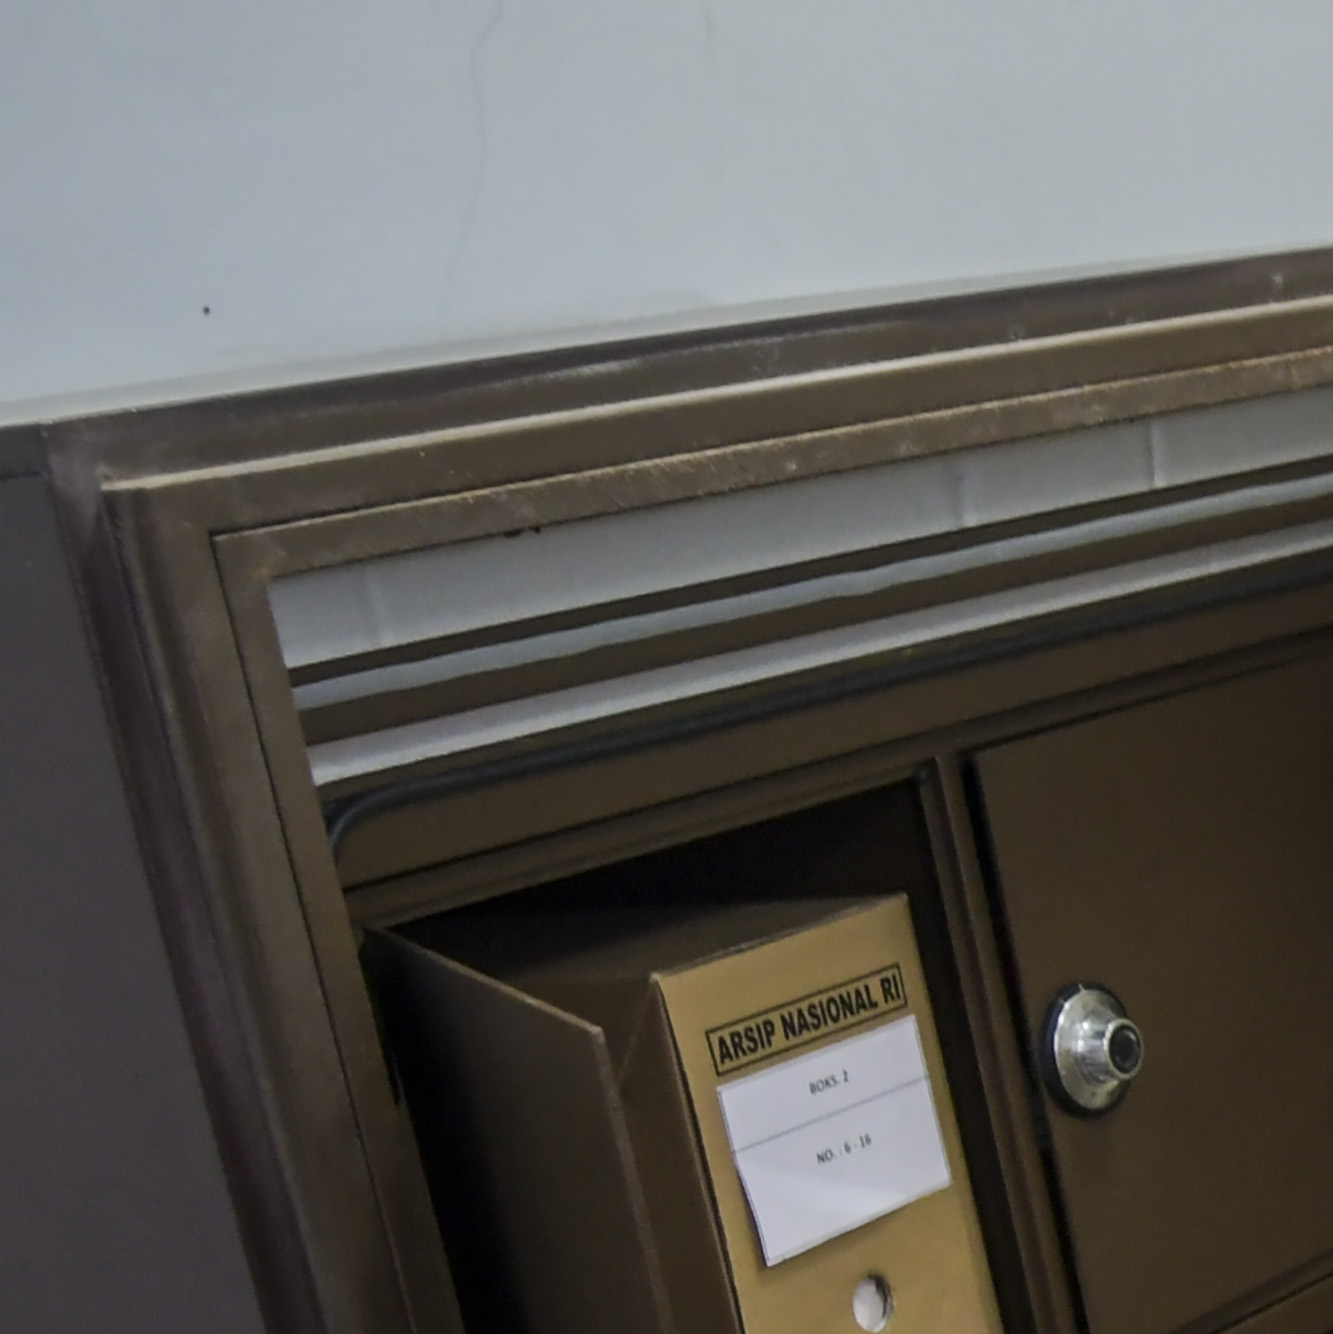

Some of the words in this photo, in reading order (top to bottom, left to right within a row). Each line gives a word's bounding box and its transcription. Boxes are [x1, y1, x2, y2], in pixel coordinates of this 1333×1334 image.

[718, 1018, 776, 1064] ARSIP
[780, 984, 878, 1041] NASIONAL
[880, 973, 901, 1003] RI
